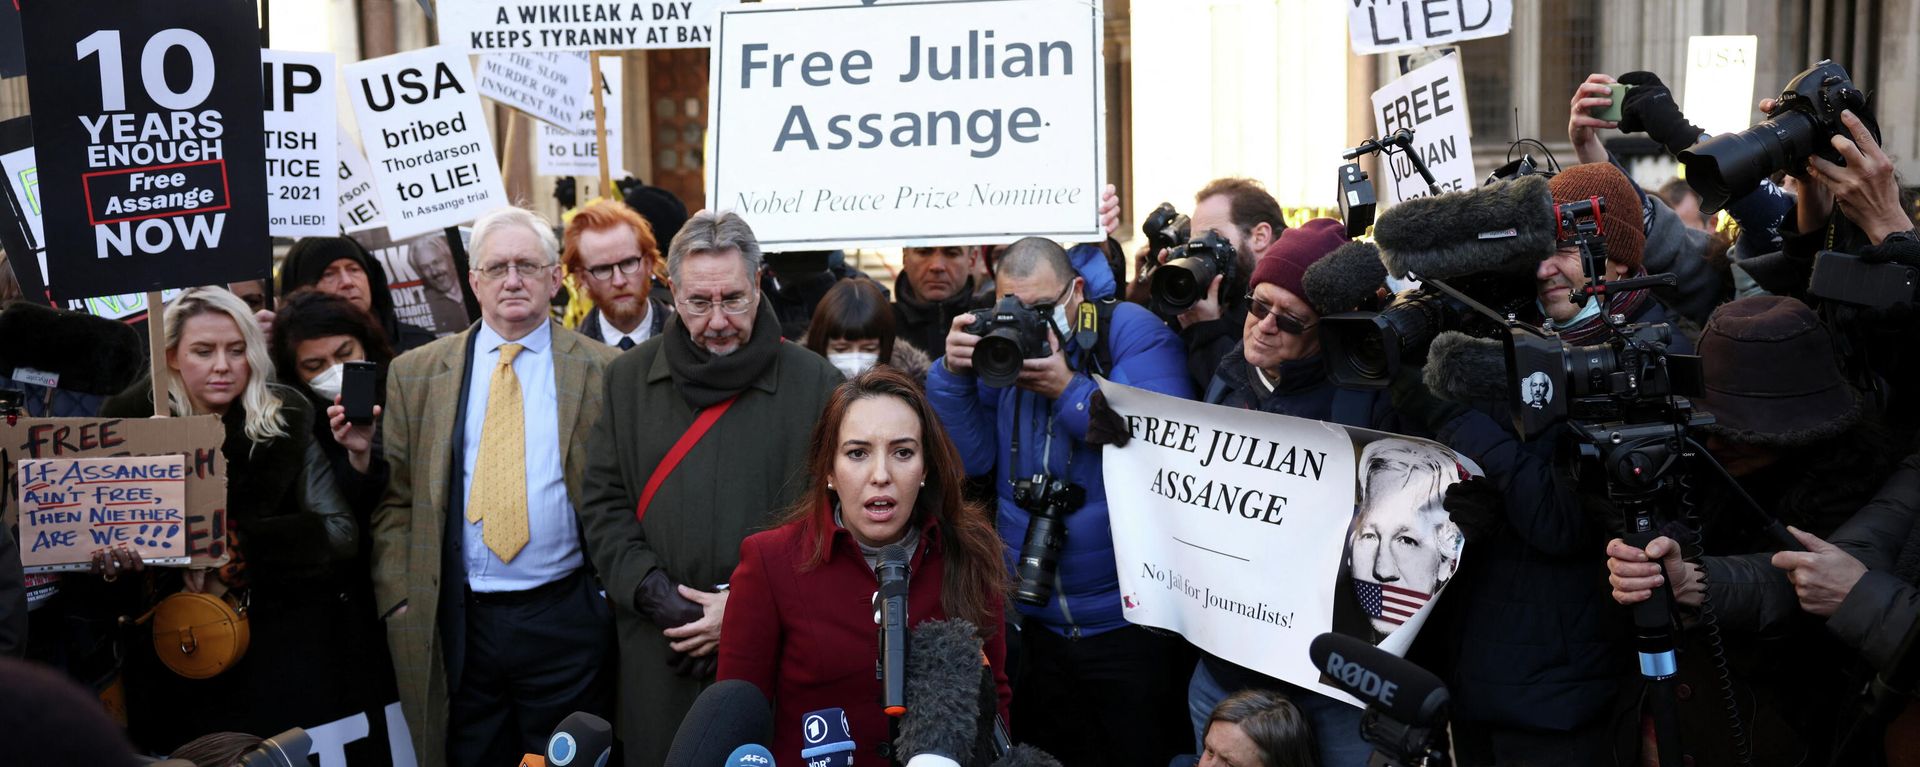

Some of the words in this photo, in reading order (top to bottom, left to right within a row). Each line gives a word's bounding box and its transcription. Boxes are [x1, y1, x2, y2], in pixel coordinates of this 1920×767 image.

[496, 6, 509, 24] A
[518, 4, 621, 24] WIKILEAK
[630, 3, 643, 21] A
[652, 2, 692, 20] DAY
[1368, 0, 1492, 45] LIED
[471, 30, 532, 49] KEEPS
[540, 28, 637, 47] TYRANNY
[646, 27, 668, 44] AT
[677, 26, 711, 42] BAY
[76, 28, 216, 112] 10
[536, 65, 568, 85] SLOW
[740, 42, 873, 89] Free
[899, 29, 1074, 83] Julian
[361, 61, 466, 113] USA
[481, 76, 545, 111] INNOCENT
[547, 104, 573, 124] MAN
[486, 60, 538, 91] MURDER
[542, 84, 557, 98] OF
[562, 94, 576, 107] AN
[1382, 76, 1455, 138] FREE
[78, 109, 224, 145] YEARS
[382, 111, 467, 149] bribed
[772, 104, 1042, 159] Assange
[87, 139, 223, 168] ENOUGH
[382, 141, 481, 174] Thordarson
[549, 143, 567, 156] to
[130, 172, 186, 192] Free
[280, 186, 320, 201] 2021
[396, 181, 424, 201] to
[430, 163, 482, 194] LIE!
[735, 191, 804, 216] Nobel
[813, 188, 885, 213] Peace
[894, 185, 960, 210] Prize
[968, 182, 1083, 208] Nominee
[105, 187, 215, 215] Assange
[402, 208, 414, 219] In
[417, 197, 465, 216] Assange
[467, 190, 489, 204] trial
[95, 213, 226, 259] NOW
[291, 214, 325, 226] LIED!
[21, 420, 126, 458] FREE
[1125, 414, 1200, 453] FREE
[1200, 429, 1327, 481] JULIAN
[59, 461, 183, 485] ASSANGE
[24, 486, 85, 503] AIN'T
[92, 486, 162, 505] FREE,
[1150, 467, 1288, 526] ASSANGE
[25, 507, 82, 526] THEN
[89, 507, 183, 528] NIETHER
[31, 530, 77, 552] ARE
[1141, 562, 1165, 582] No
[1166, 569, 1183, 591] Jail
[1184, 580, 1201, 600] for
[1202, 587, 1294, 629] Journalists!
[1326, 651, 1399, 707] RØDE
[740, 754, 768, 764] AFP
